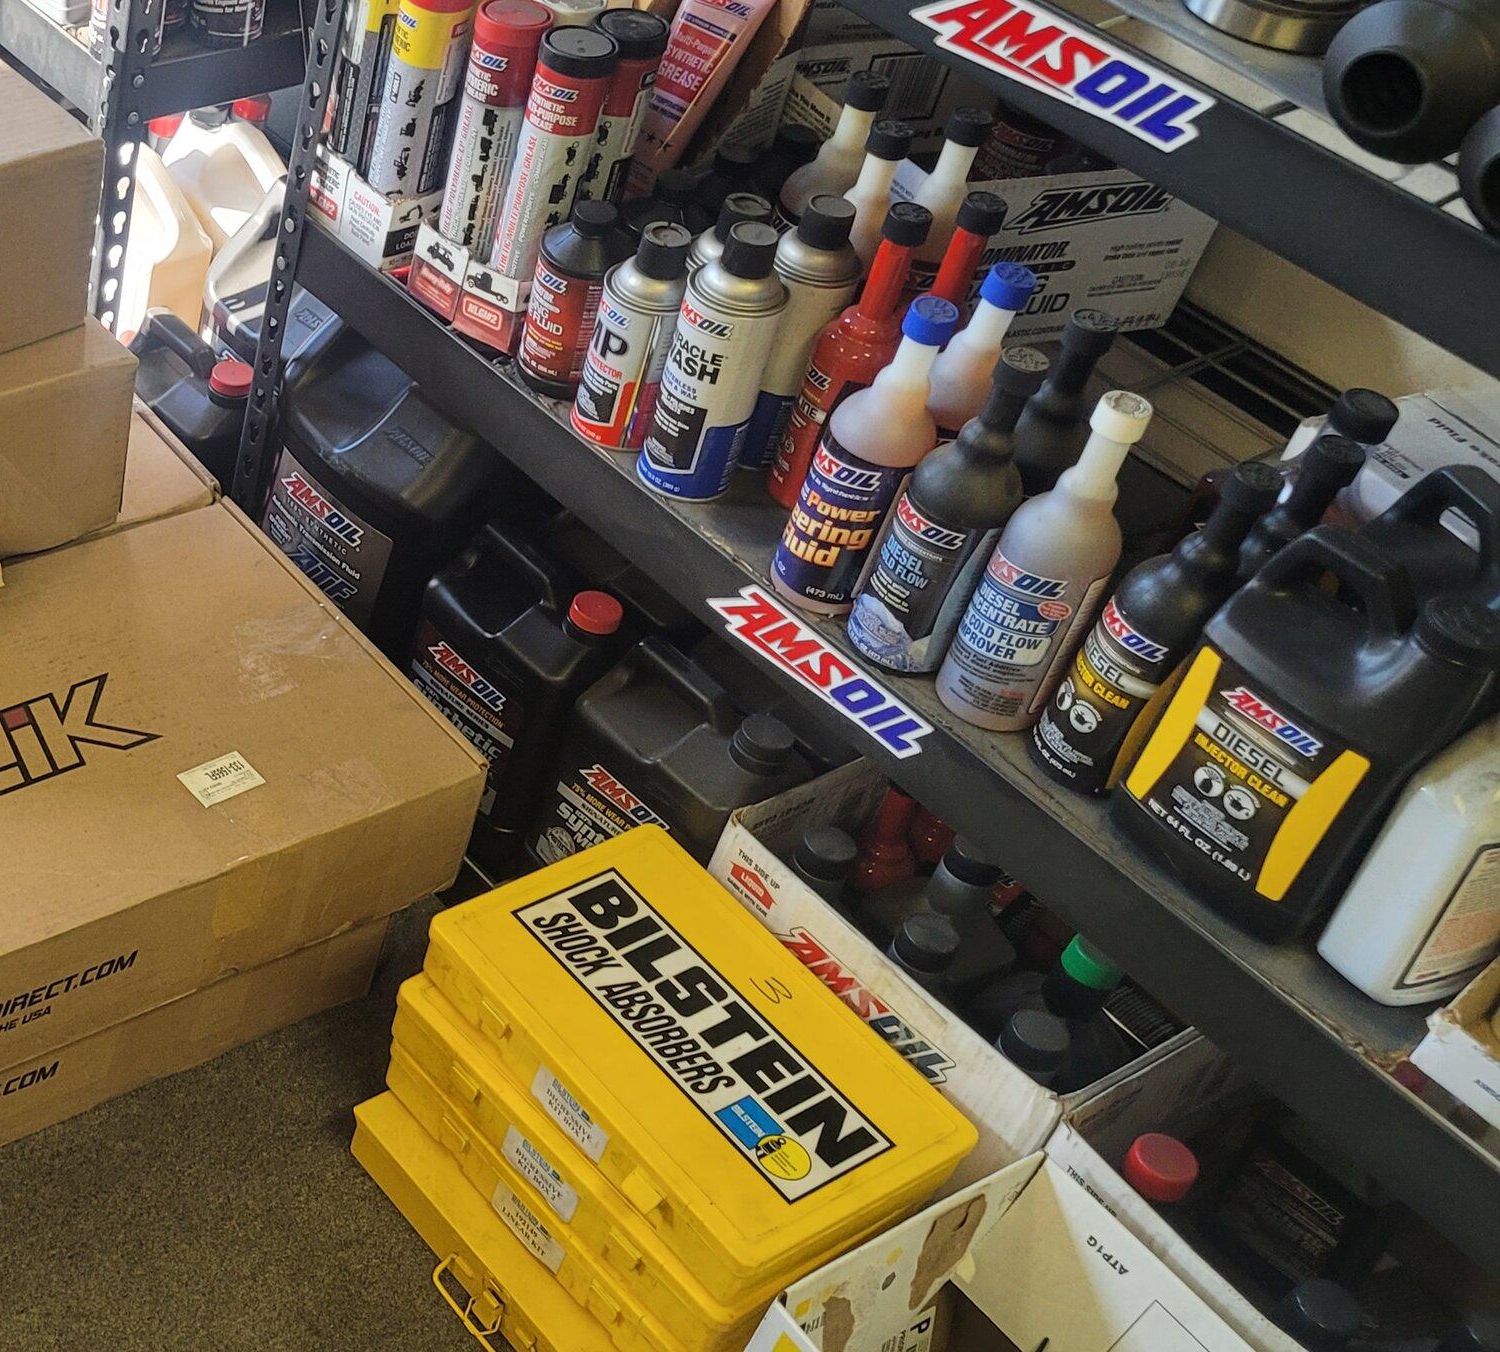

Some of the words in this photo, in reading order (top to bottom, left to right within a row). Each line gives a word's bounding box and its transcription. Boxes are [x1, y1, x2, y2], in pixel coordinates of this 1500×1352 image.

[658, 61, 704, 91] GREASE
[665, 44, 714, 74] SYNTHETIC
[927, 0, 1202, 144] AMSOIL
[523, 134, 538, 170] GREASE
[1005, 181, 1175, 233] AMSOIL
[982, 240, 1071, 266] OMINATOR
[1014, 294, 1071, 317] LUID
[533, 313, 563, 337] FLUID
[675, 331, 724, 367] RACLE
[283, 473, 364, 546] AMSOIL
[806, 492, 881, 523] Power
[305, 517, 348, 555] SYNTHETIC
[791, 503, 875, 550] eering
[288, 544, 358, 600] ATF
[341, 562, 361, 581] Fluid
[886, 534, 924, 576] DIESEL
[805, 585, 825, 598] (473
[826, 590, 845, 601] mL)
[895, 563, 930, 590] FLOW
[980, 581, 1021, 616] DIESEL
[968, 613, 995, 638] COLD
[998, 631, 1044, 650] FLOW
[431, 643, 504, 711] AMSOIL
[718, 591, 924, 752] AMSOIL
[450, 682, 467, 702] WEAR
[467, 697, 504, 728] PROTECTION
[1093, 682, 1131, 711] CLEAN
[1223, 688, 1323, 757] AMSOIL
[1194, 732, 1248, 781] INJECTOR
[1247, 774, 1288, 809] CLEAN
[1212, 722, 1285, 789] DIESEL
[586, 793, 605, 812] MORE
[605, 806, 626, 827] WEAR
[1148, 798, 1167, 819] NET
[738, 848, 755, 866] THIS
[754, 863, 770, 882] SIDE
[770, 877, 781, 890] UP
[21, 1005, 52, 1026] USA
[532, 911, 622, 977] SHOCK
[595, 980, 736, 1095] ABSORBERS
[779, 930, 949, 1080] AMSOIL
[567, 878, 880, 1169] BILSTEIN
[546, 1088, 593, 1142] DIGRESSIVE
[547, 1099, 563, 1117] KIT
[562, 1113, 581, 1135] BOX
[515, 1147, 564, 1200] DIGRESSIVE
[517, 1158, 533, 1176] KIT
[532, 1172, 551, 1195] BOX
[1066, 1164, 1086, 1187] THIS
[502, 1206, 531, 1244] LINEAR
[531, 1239, 548, 1257] KIT
